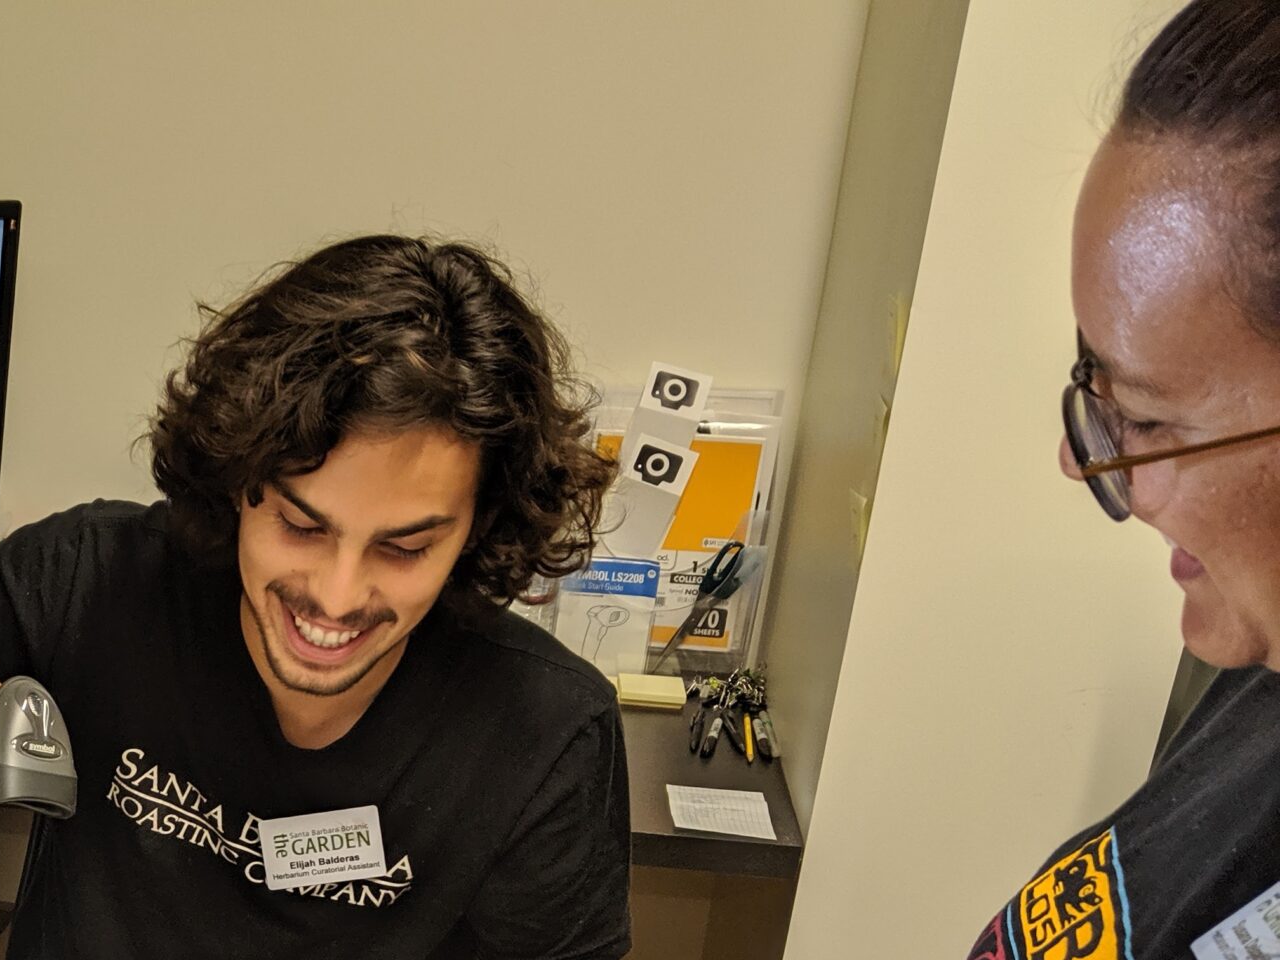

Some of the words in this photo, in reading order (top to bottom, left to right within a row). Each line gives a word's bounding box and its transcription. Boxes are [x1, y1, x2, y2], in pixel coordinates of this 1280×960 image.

[611, 571, 644, 584] LS2208
[673, 575, 704, 584] COLLEG
[693, 627, 720, 636] SHEETS
[115, 748, 224, 834] SANTA
[289, 831, 310, 840] Santa
[311, 827, 340, 837] Barbara
[341, 822, 369, 832] Botanic
[273, 833, 289, 859] the
[291, 830, 371, 856] GARDEN
[272, 870, 310, 881] Herbarium
[311, 865, 346, 876] Curatorial
[347, 861, 381, 871] Assistant
[289, 859, 316, 870] Elijah
[318, 854, 360, 866] Balderas
